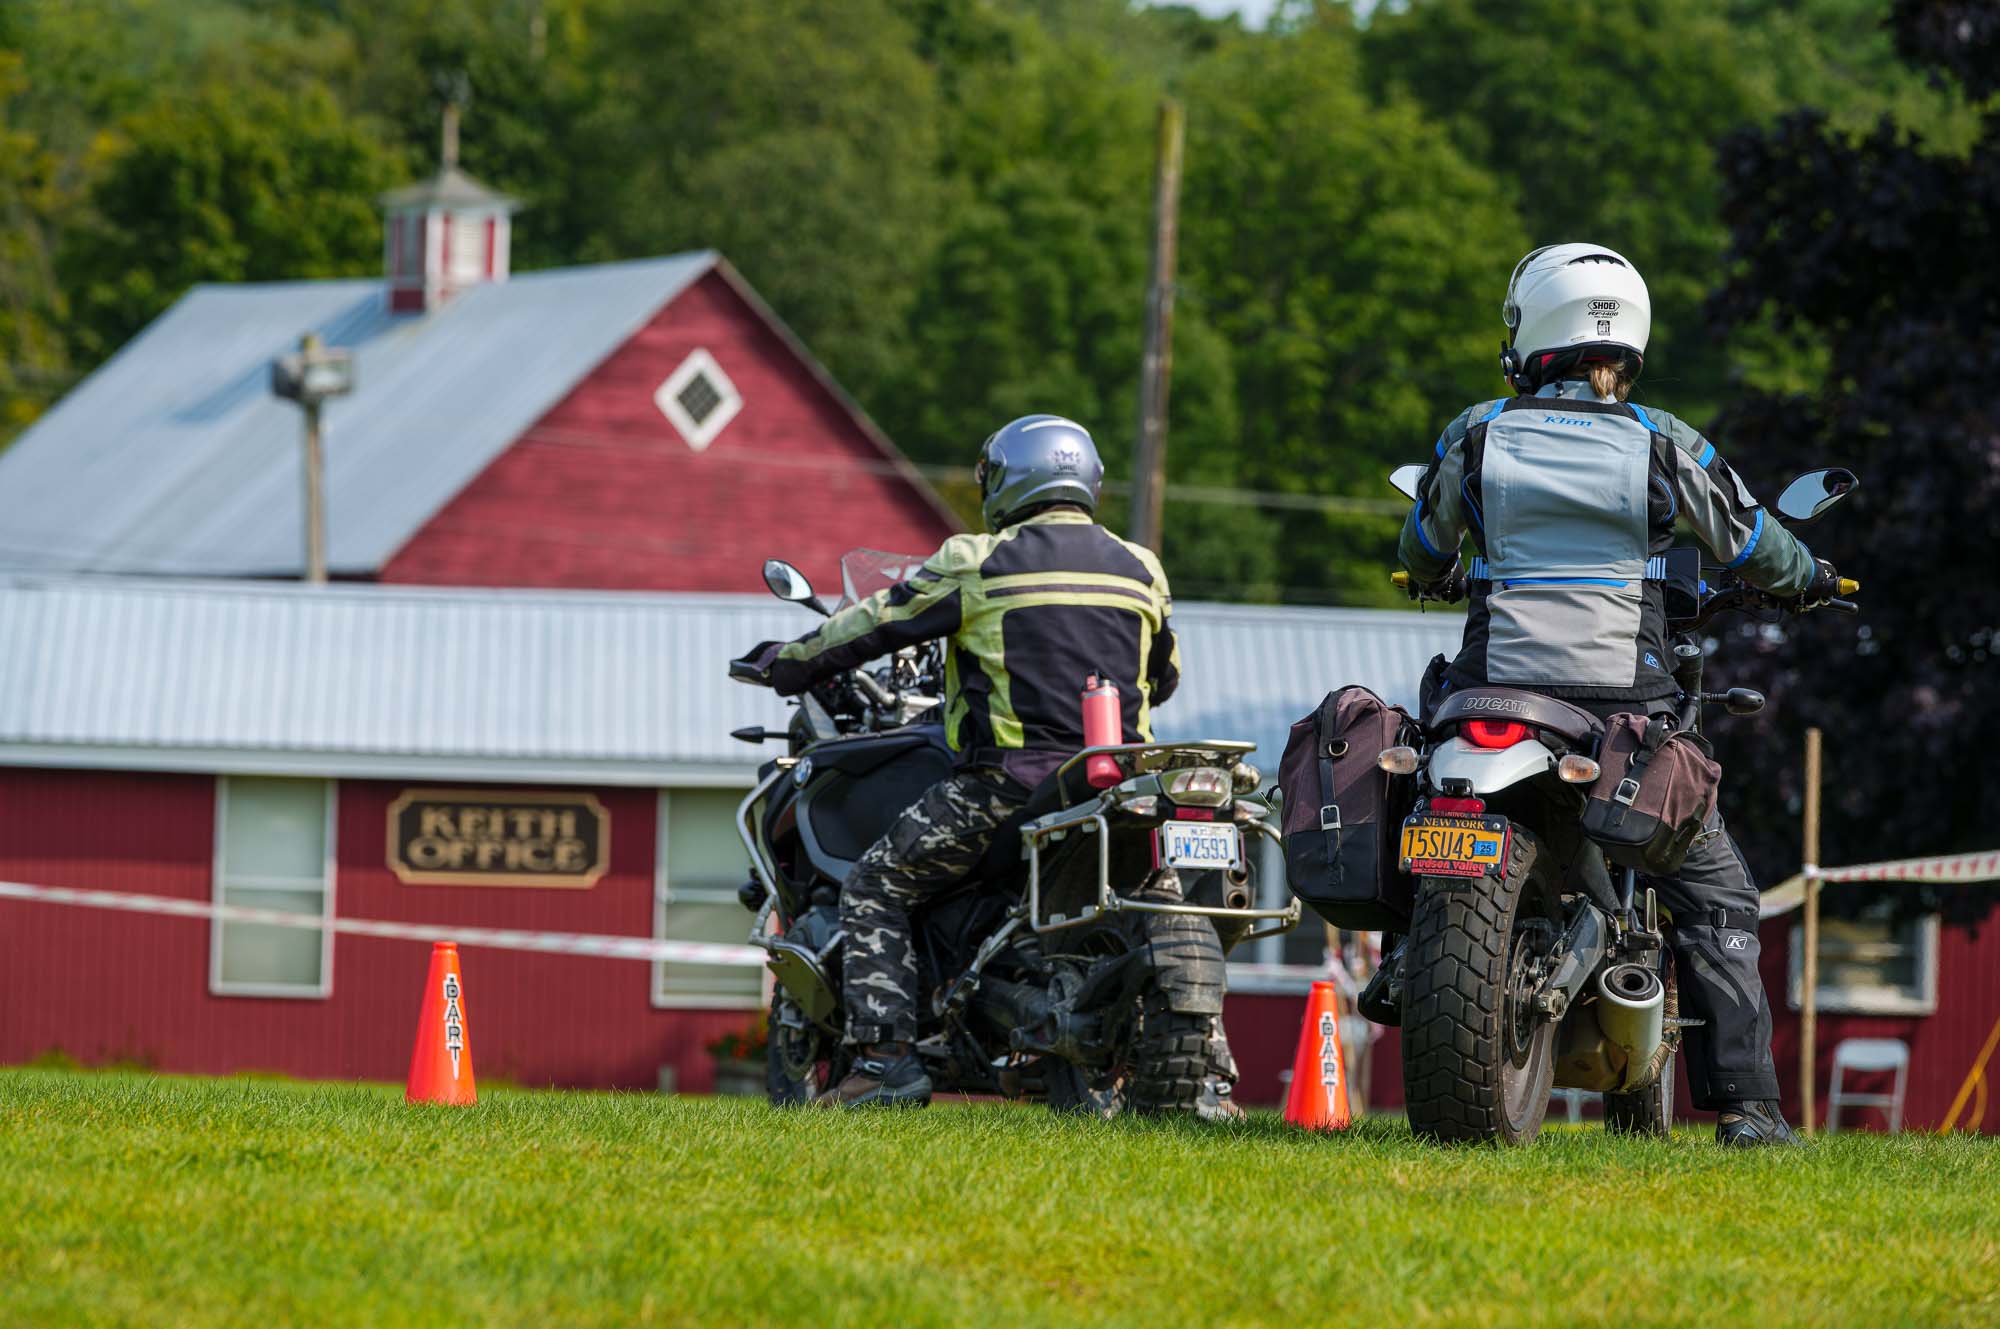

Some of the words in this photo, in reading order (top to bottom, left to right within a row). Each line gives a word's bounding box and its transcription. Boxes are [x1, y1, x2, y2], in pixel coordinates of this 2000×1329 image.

[1592, 301, 1616, 310] SHOEI
[1463, 697, 1530, 716] DUCATI
[421, 806, 576, 839] KEITH
[1423, 817, 1451, 827] NEW
[1455, 819, 1486, 830] YORK
[407, 836, 588, 871] OFFICE
[1407, 829, 1477, 859] 15SU43
[1480, 844, 1492, 853] 25
[1728, 936, 1746, 948] K
[444, 980, 462, 1065] DART
